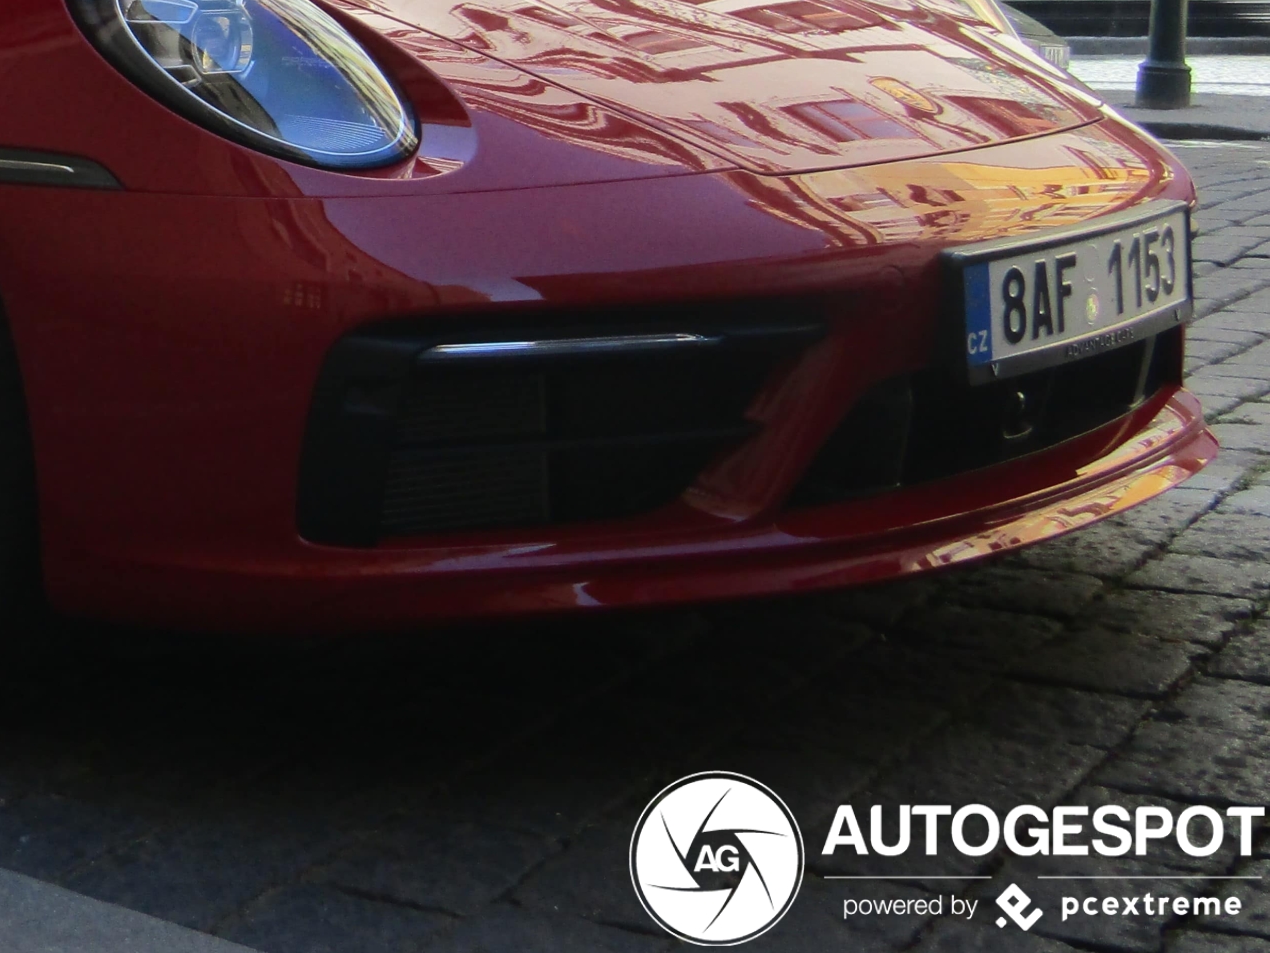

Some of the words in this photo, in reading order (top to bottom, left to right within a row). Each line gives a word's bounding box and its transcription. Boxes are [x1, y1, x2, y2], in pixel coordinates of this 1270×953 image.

[1002, 251, 1077, 345] 8AF
[1107, 222, 1176, 316] 1153
[967, 329, 988, 355] CZ
